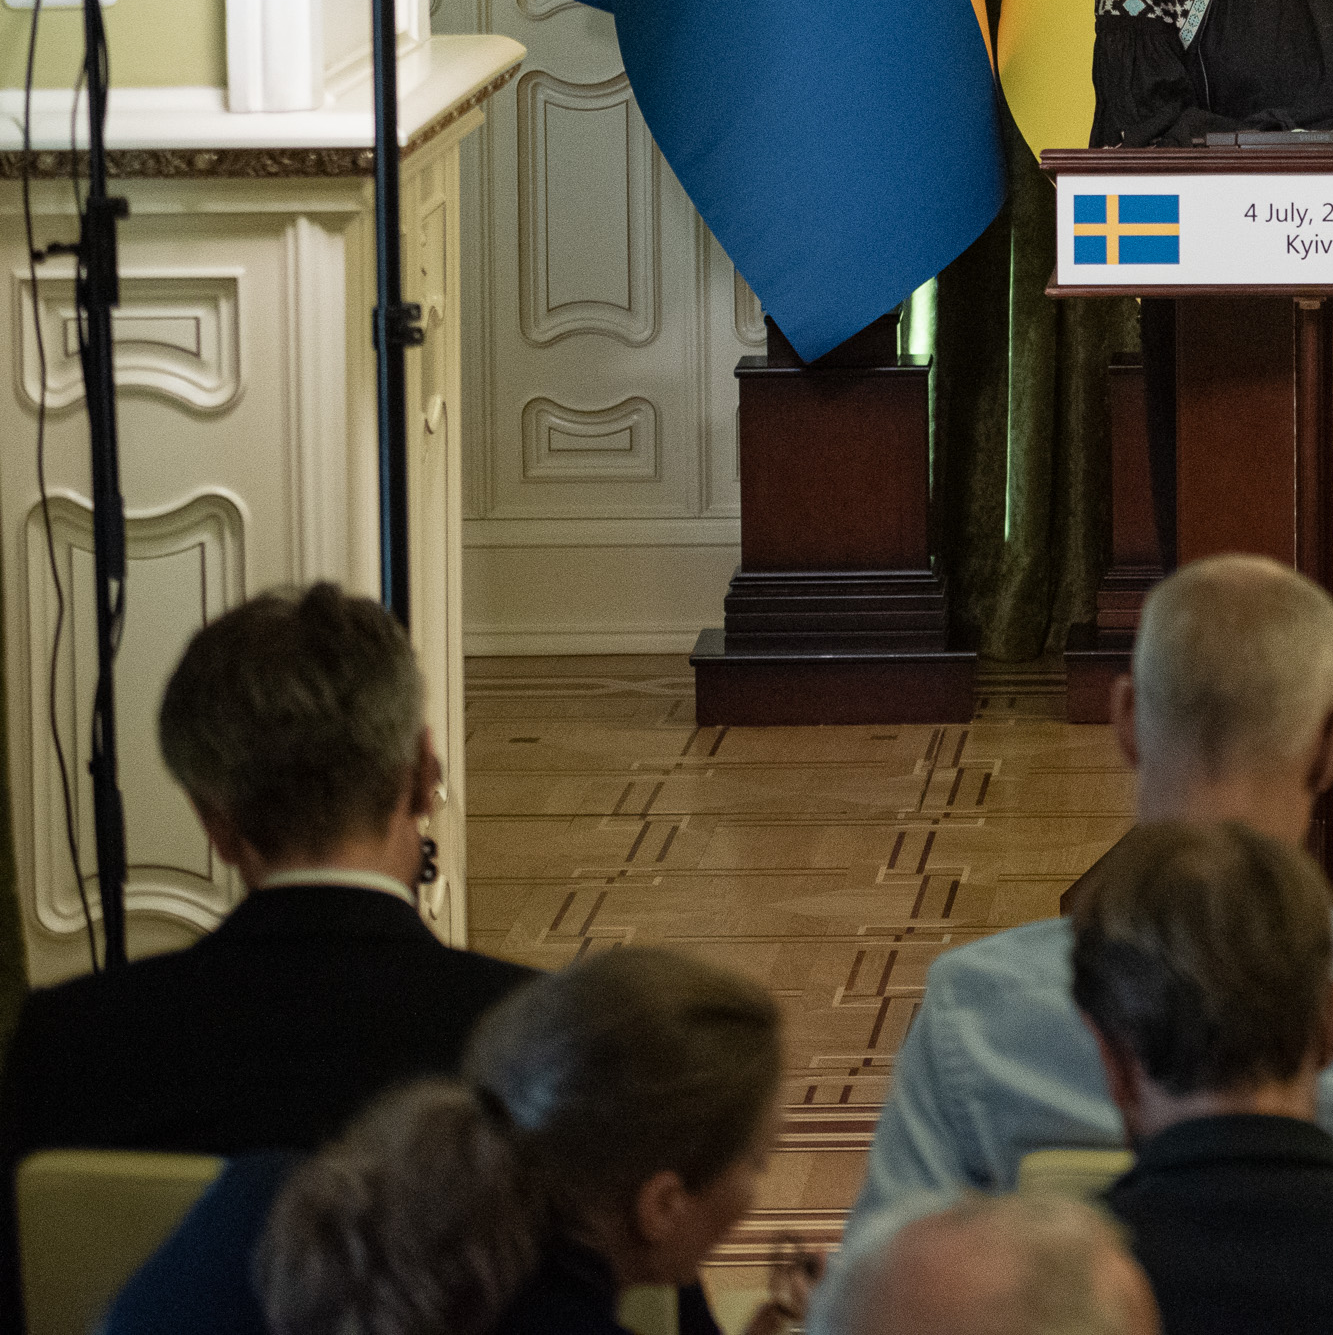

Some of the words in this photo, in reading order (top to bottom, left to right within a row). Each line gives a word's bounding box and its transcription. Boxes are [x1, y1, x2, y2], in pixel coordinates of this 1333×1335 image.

[1243, 203, 1258, 223] 4
[1265, 201, 1313, 228] July,
[1286, 233, 1333, 261] Kyiv
